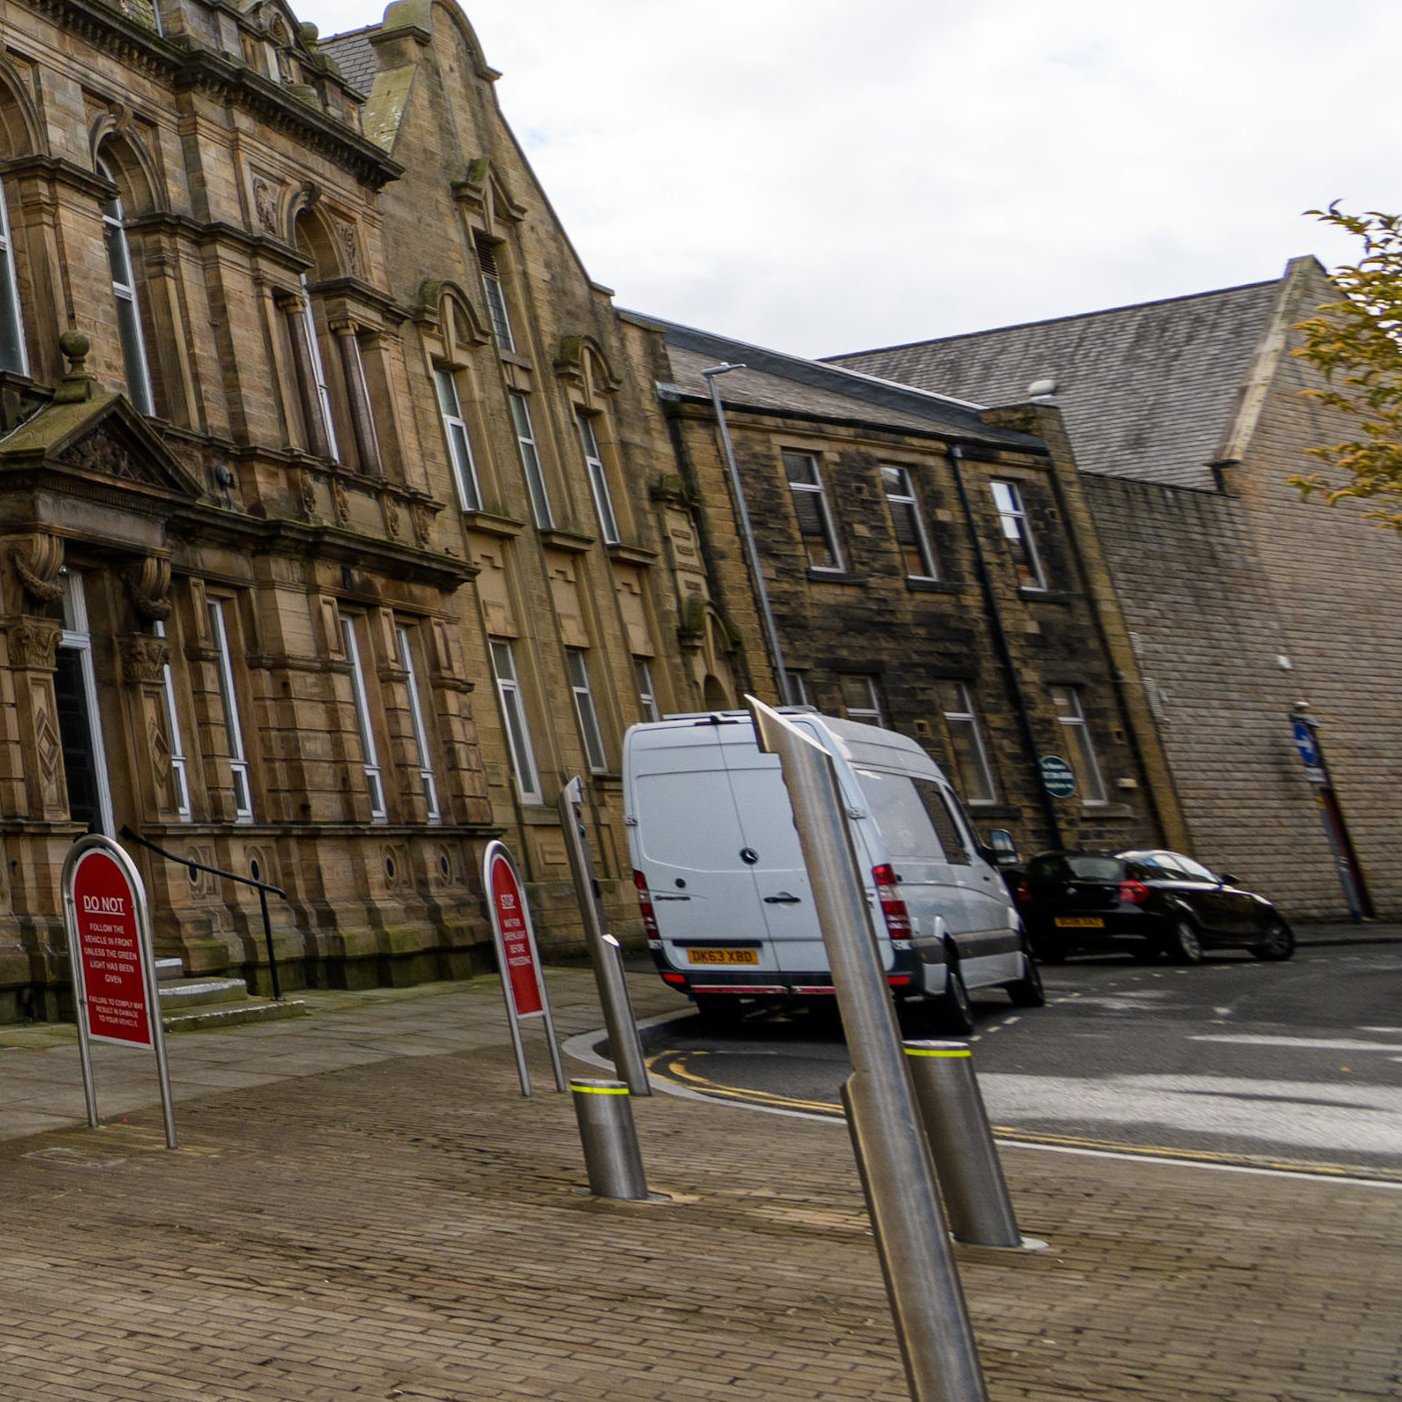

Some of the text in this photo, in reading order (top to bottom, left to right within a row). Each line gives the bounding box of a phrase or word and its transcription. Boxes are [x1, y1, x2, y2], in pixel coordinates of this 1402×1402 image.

[82, 895, 125, 913] DO NOT
[89, 922, 125, 934] FOLLOW THE
[83, 935, 134, 947] VEHICLE IN FRONT
[83, 947, 138, 960] UNLESS THE GREEN
[692, 950, 753, 963] DK63 XBD
[89, 960, 135, 973] LIGHT HAS BEEN
[104, 973, 122, 984] GIVEN
[108, 998, 115, 1006] TO
